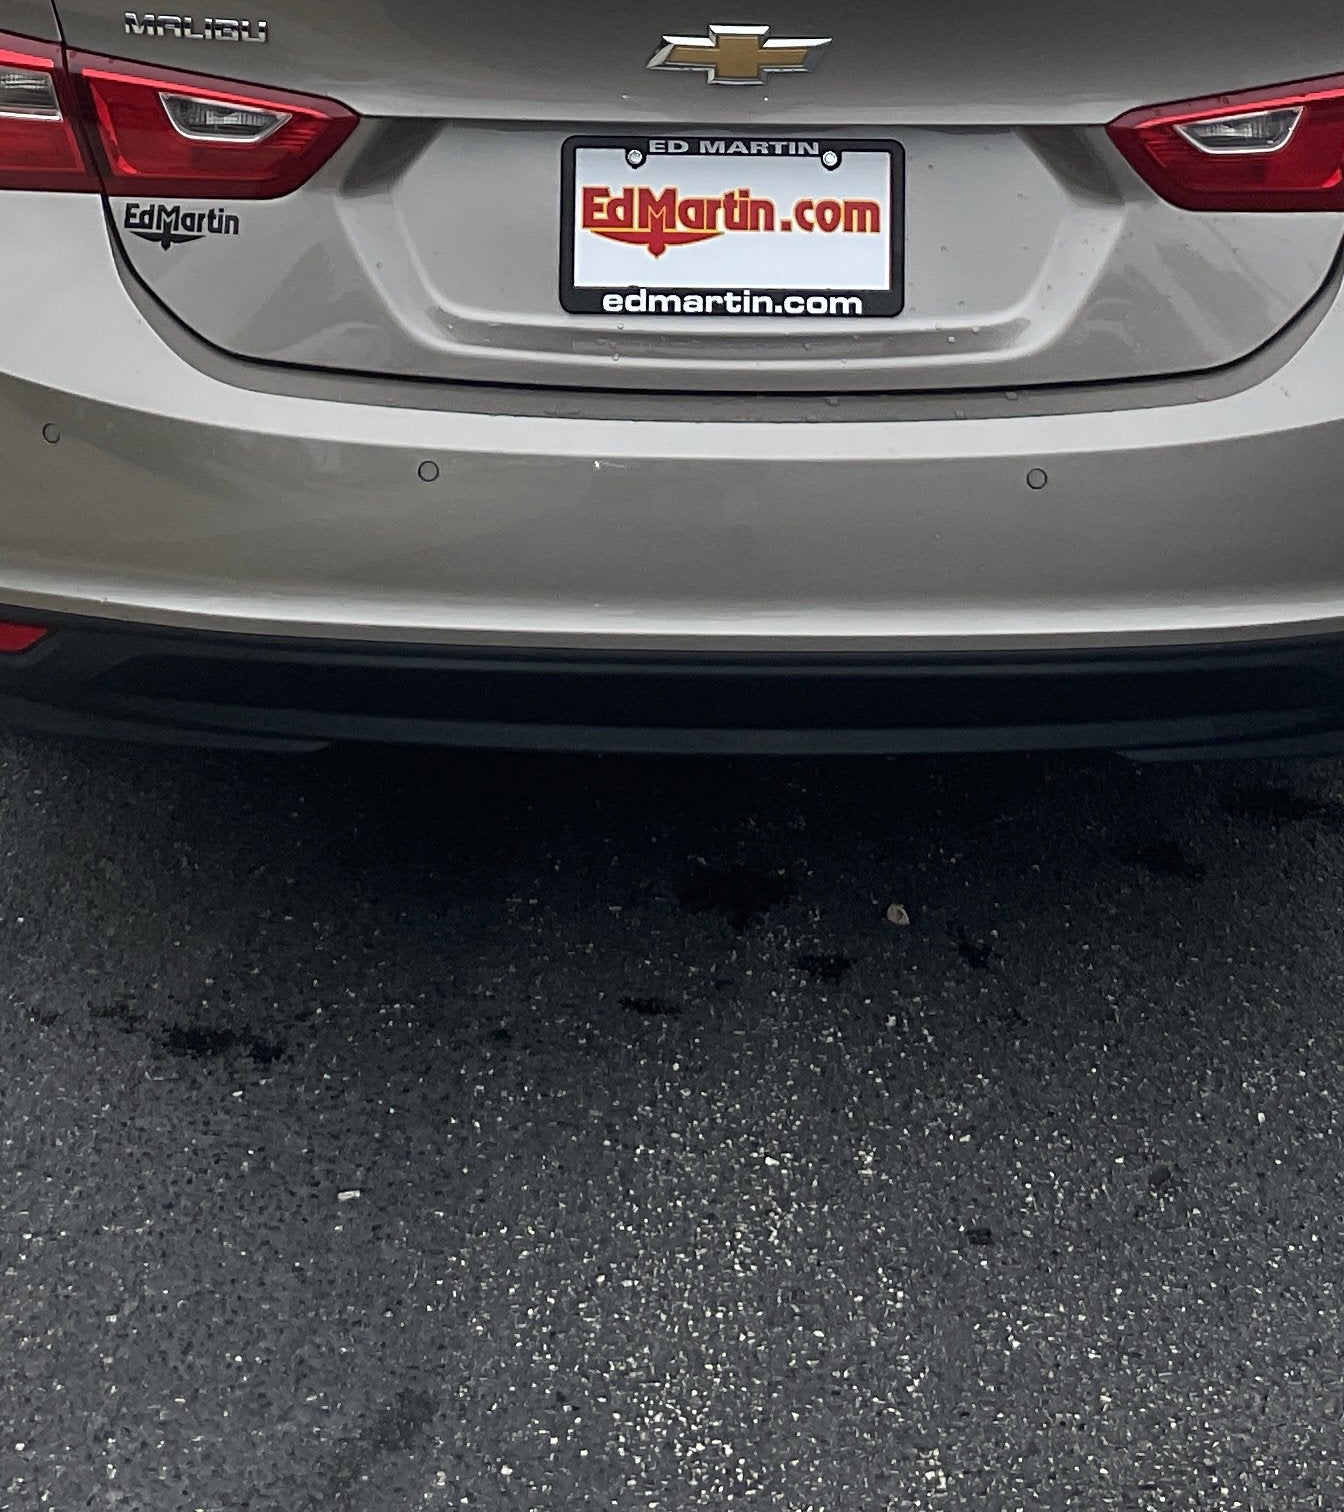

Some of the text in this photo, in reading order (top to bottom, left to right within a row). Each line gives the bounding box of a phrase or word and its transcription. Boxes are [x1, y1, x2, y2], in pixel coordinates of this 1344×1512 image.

[124, 12, 267, 43] MALIBU
[649, 139, 820, 155] ED MARTIN
[124, 202, 240, 236] EdMartin
[582, 185, 882, 234] EdMartin.com
[602, 288, 864, 315] edmartin.com
